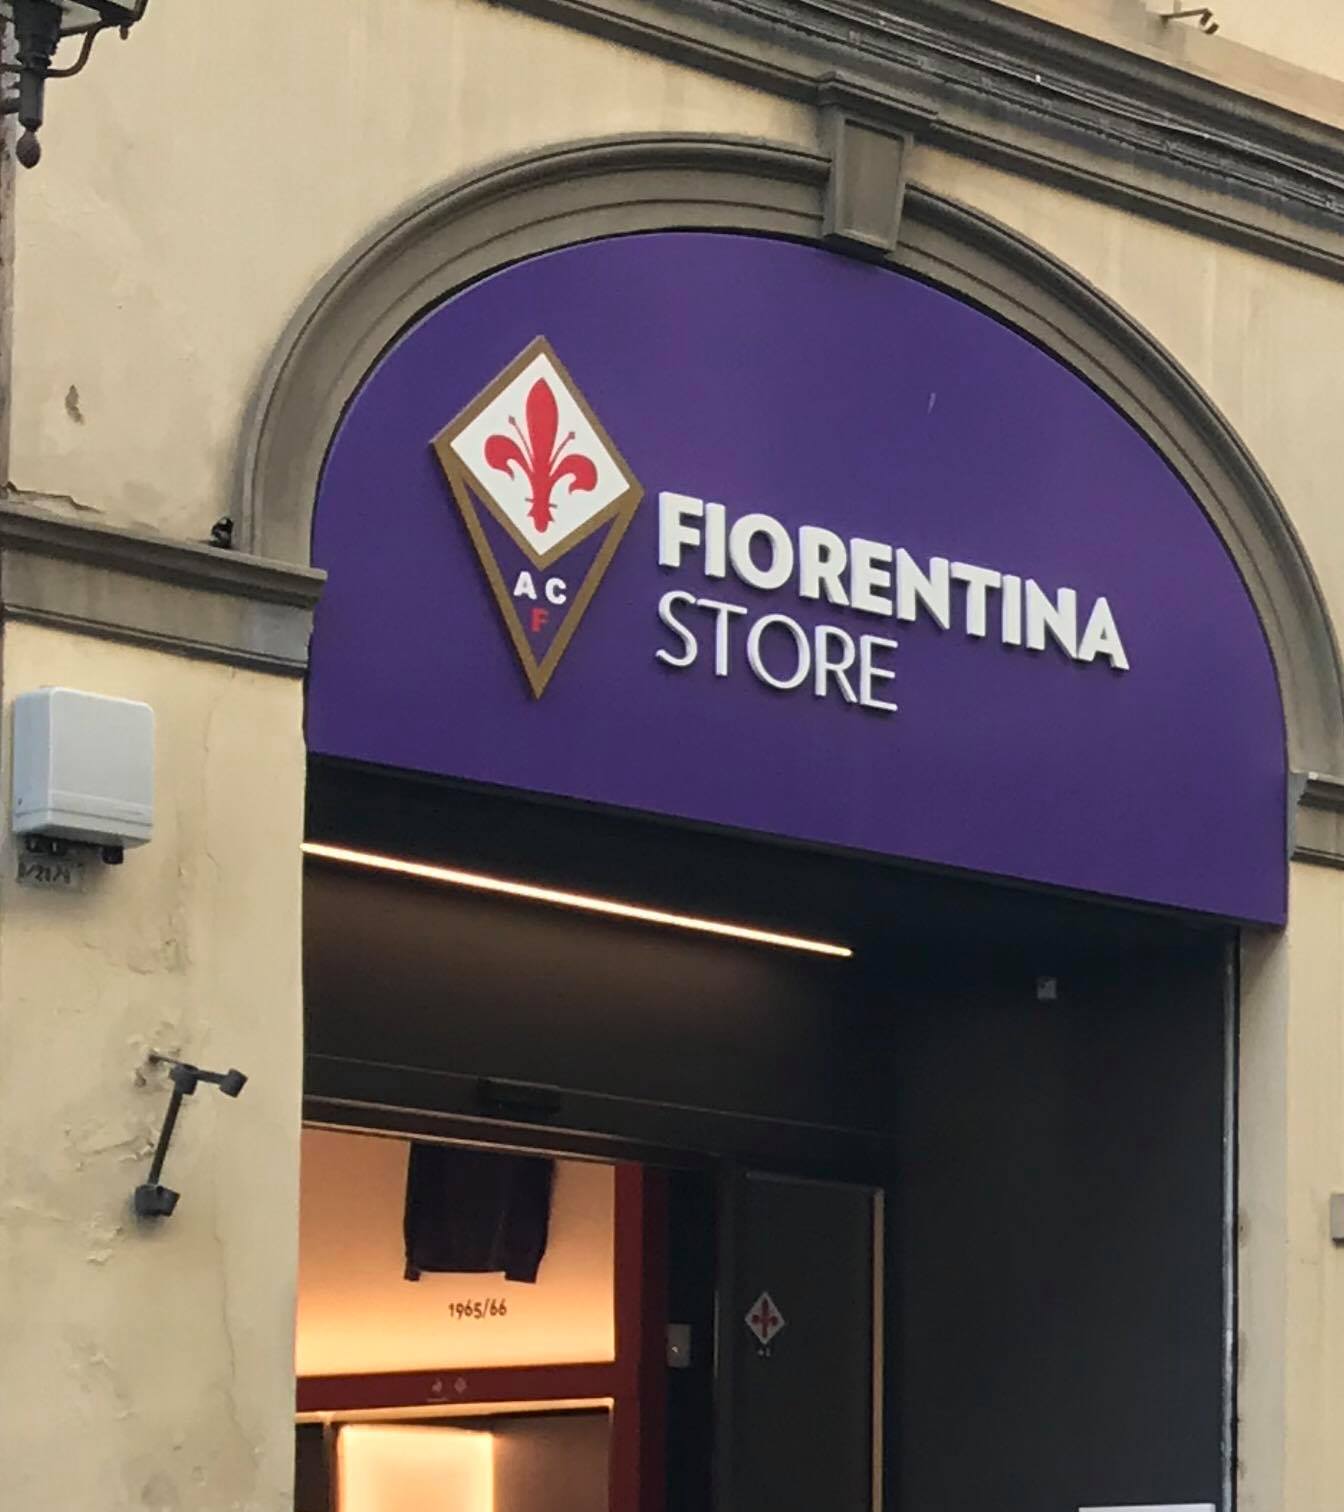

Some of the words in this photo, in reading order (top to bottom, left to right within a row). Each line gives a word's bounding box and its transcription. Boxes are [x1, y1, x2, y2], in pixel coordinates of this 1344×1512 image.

[657, 490, 1130, 672] FIORENTINA
[655, 589, 899, 713] STORE
[448, 1298, 507, 1320] 1965/66
